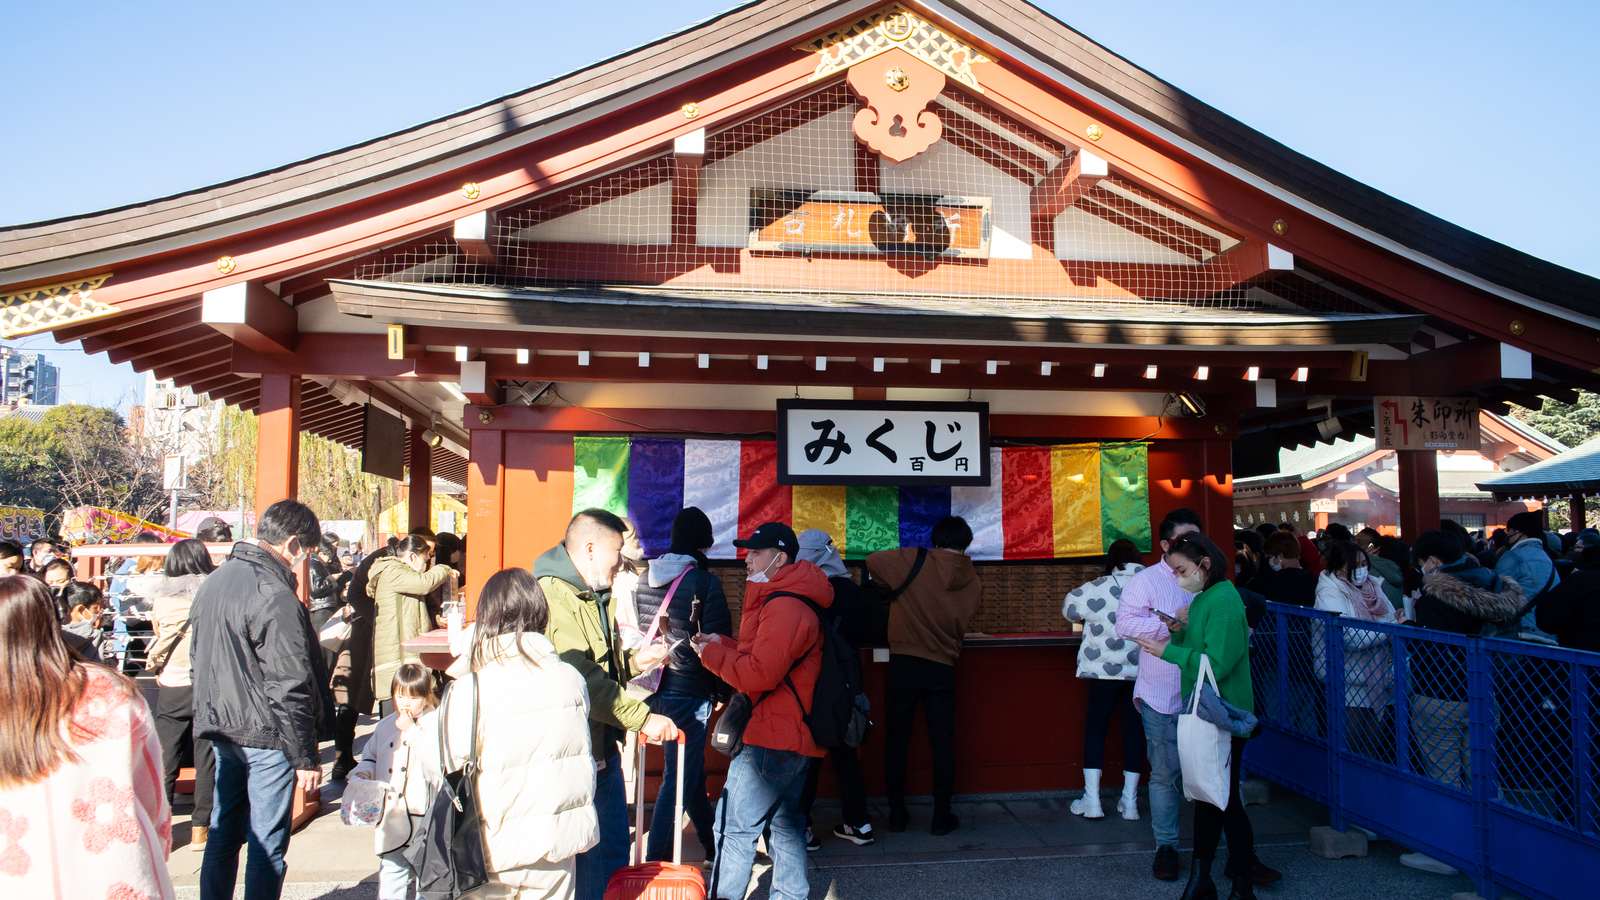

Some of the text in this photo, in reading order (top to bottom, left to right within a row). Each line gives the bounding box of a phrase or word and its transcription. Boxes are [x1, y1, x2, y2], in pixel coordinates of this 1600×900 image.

[1411, 399, 1474, 430] 朱印所
[804, 418, 962, 464] みくじ
